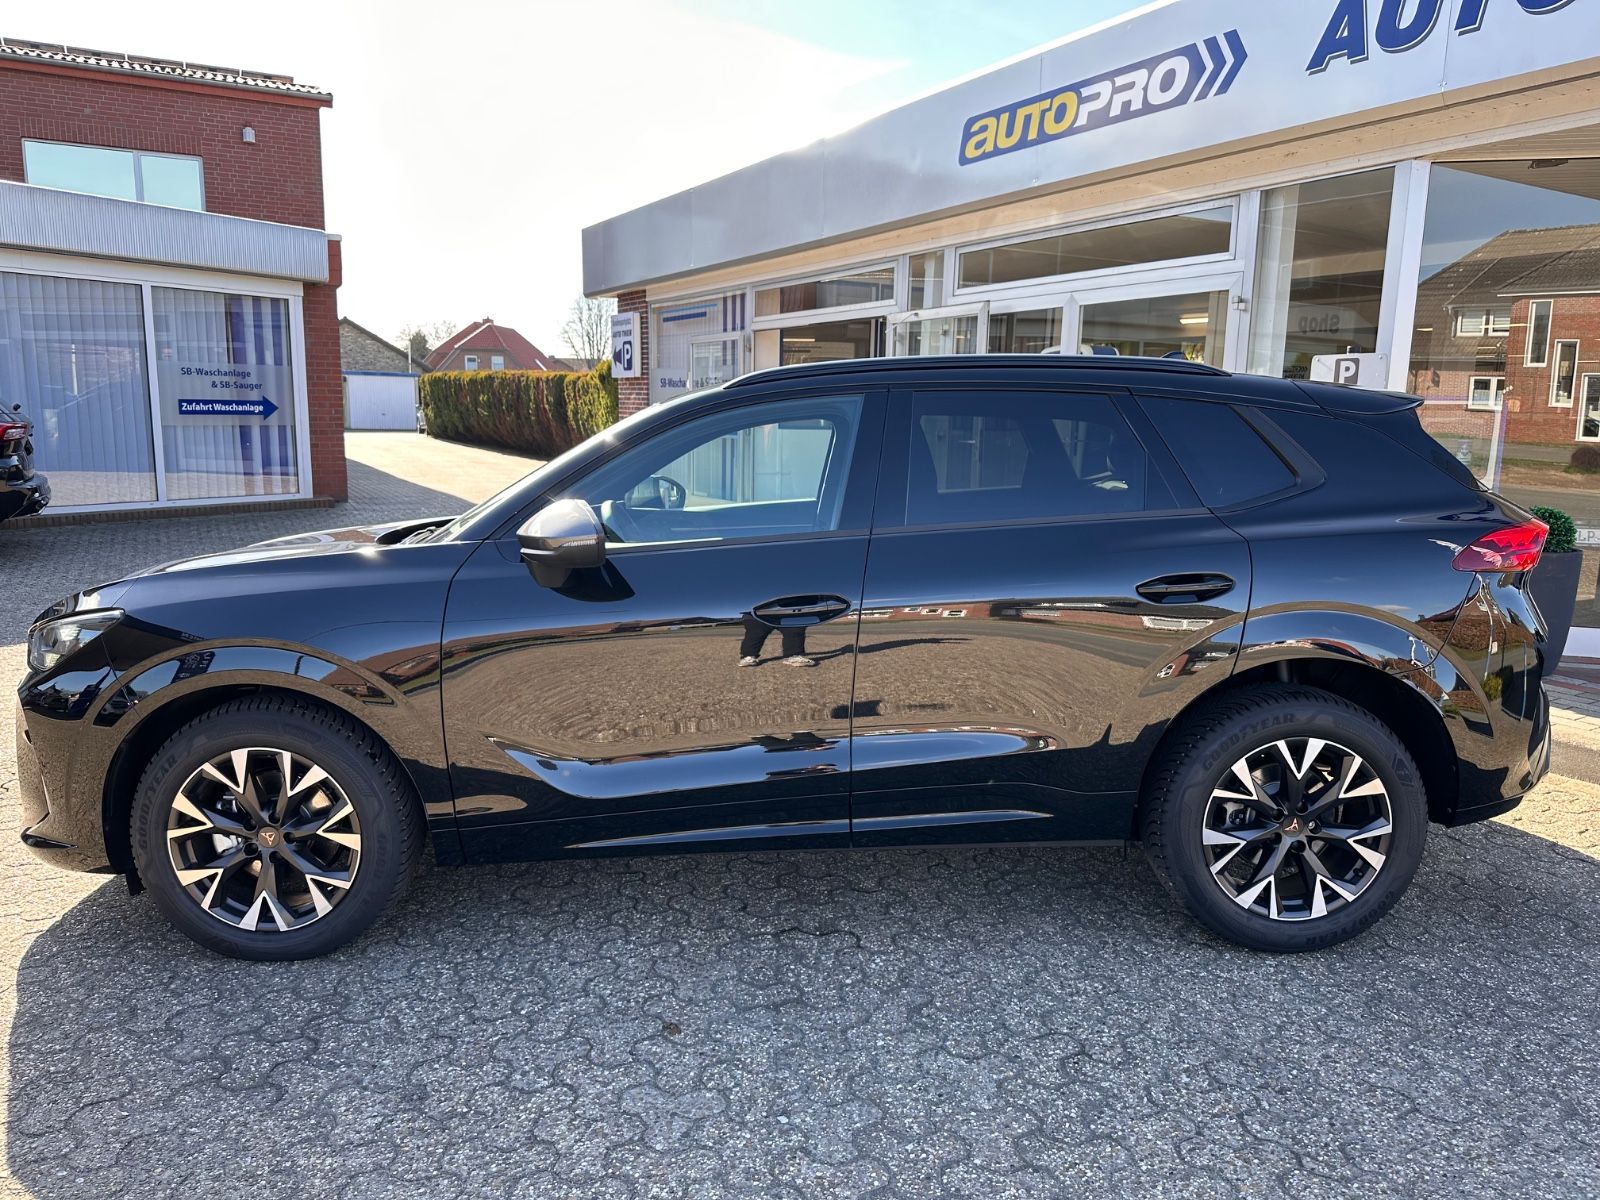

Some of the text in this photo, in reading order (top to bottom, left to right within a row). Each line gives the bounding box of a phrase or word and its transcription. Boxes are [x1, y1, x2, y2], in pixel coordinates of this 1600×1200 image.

[1305, 0, 1577, 76] AU
[624, 343, 631, 369] P
[180, 367, 252, 379] SB-Waschanlage
[1338, 360, 1357, 384] P
[211, 380, 263, 391] & SB-Sauger
[181, 402, 264, 413] Zufahrt Waschanlage
